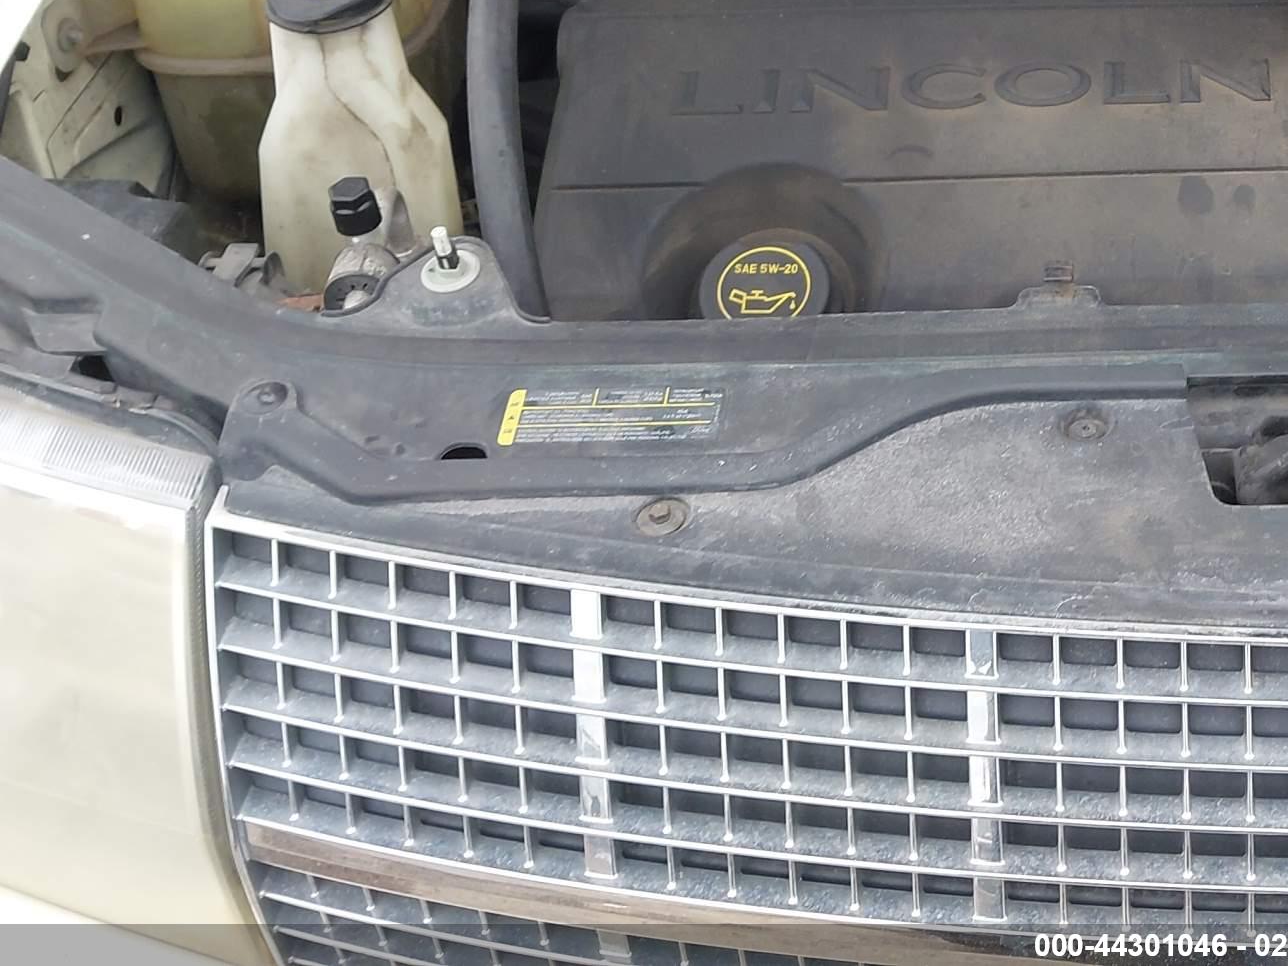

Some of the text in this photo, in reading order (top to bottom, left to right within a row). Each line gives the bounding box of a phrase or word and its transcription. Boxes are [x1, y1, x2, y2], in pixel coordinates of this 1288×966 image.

[672, 57, 1271, 116] LINCOLN
[734, 263, 799, 274] SAE 5W-20
